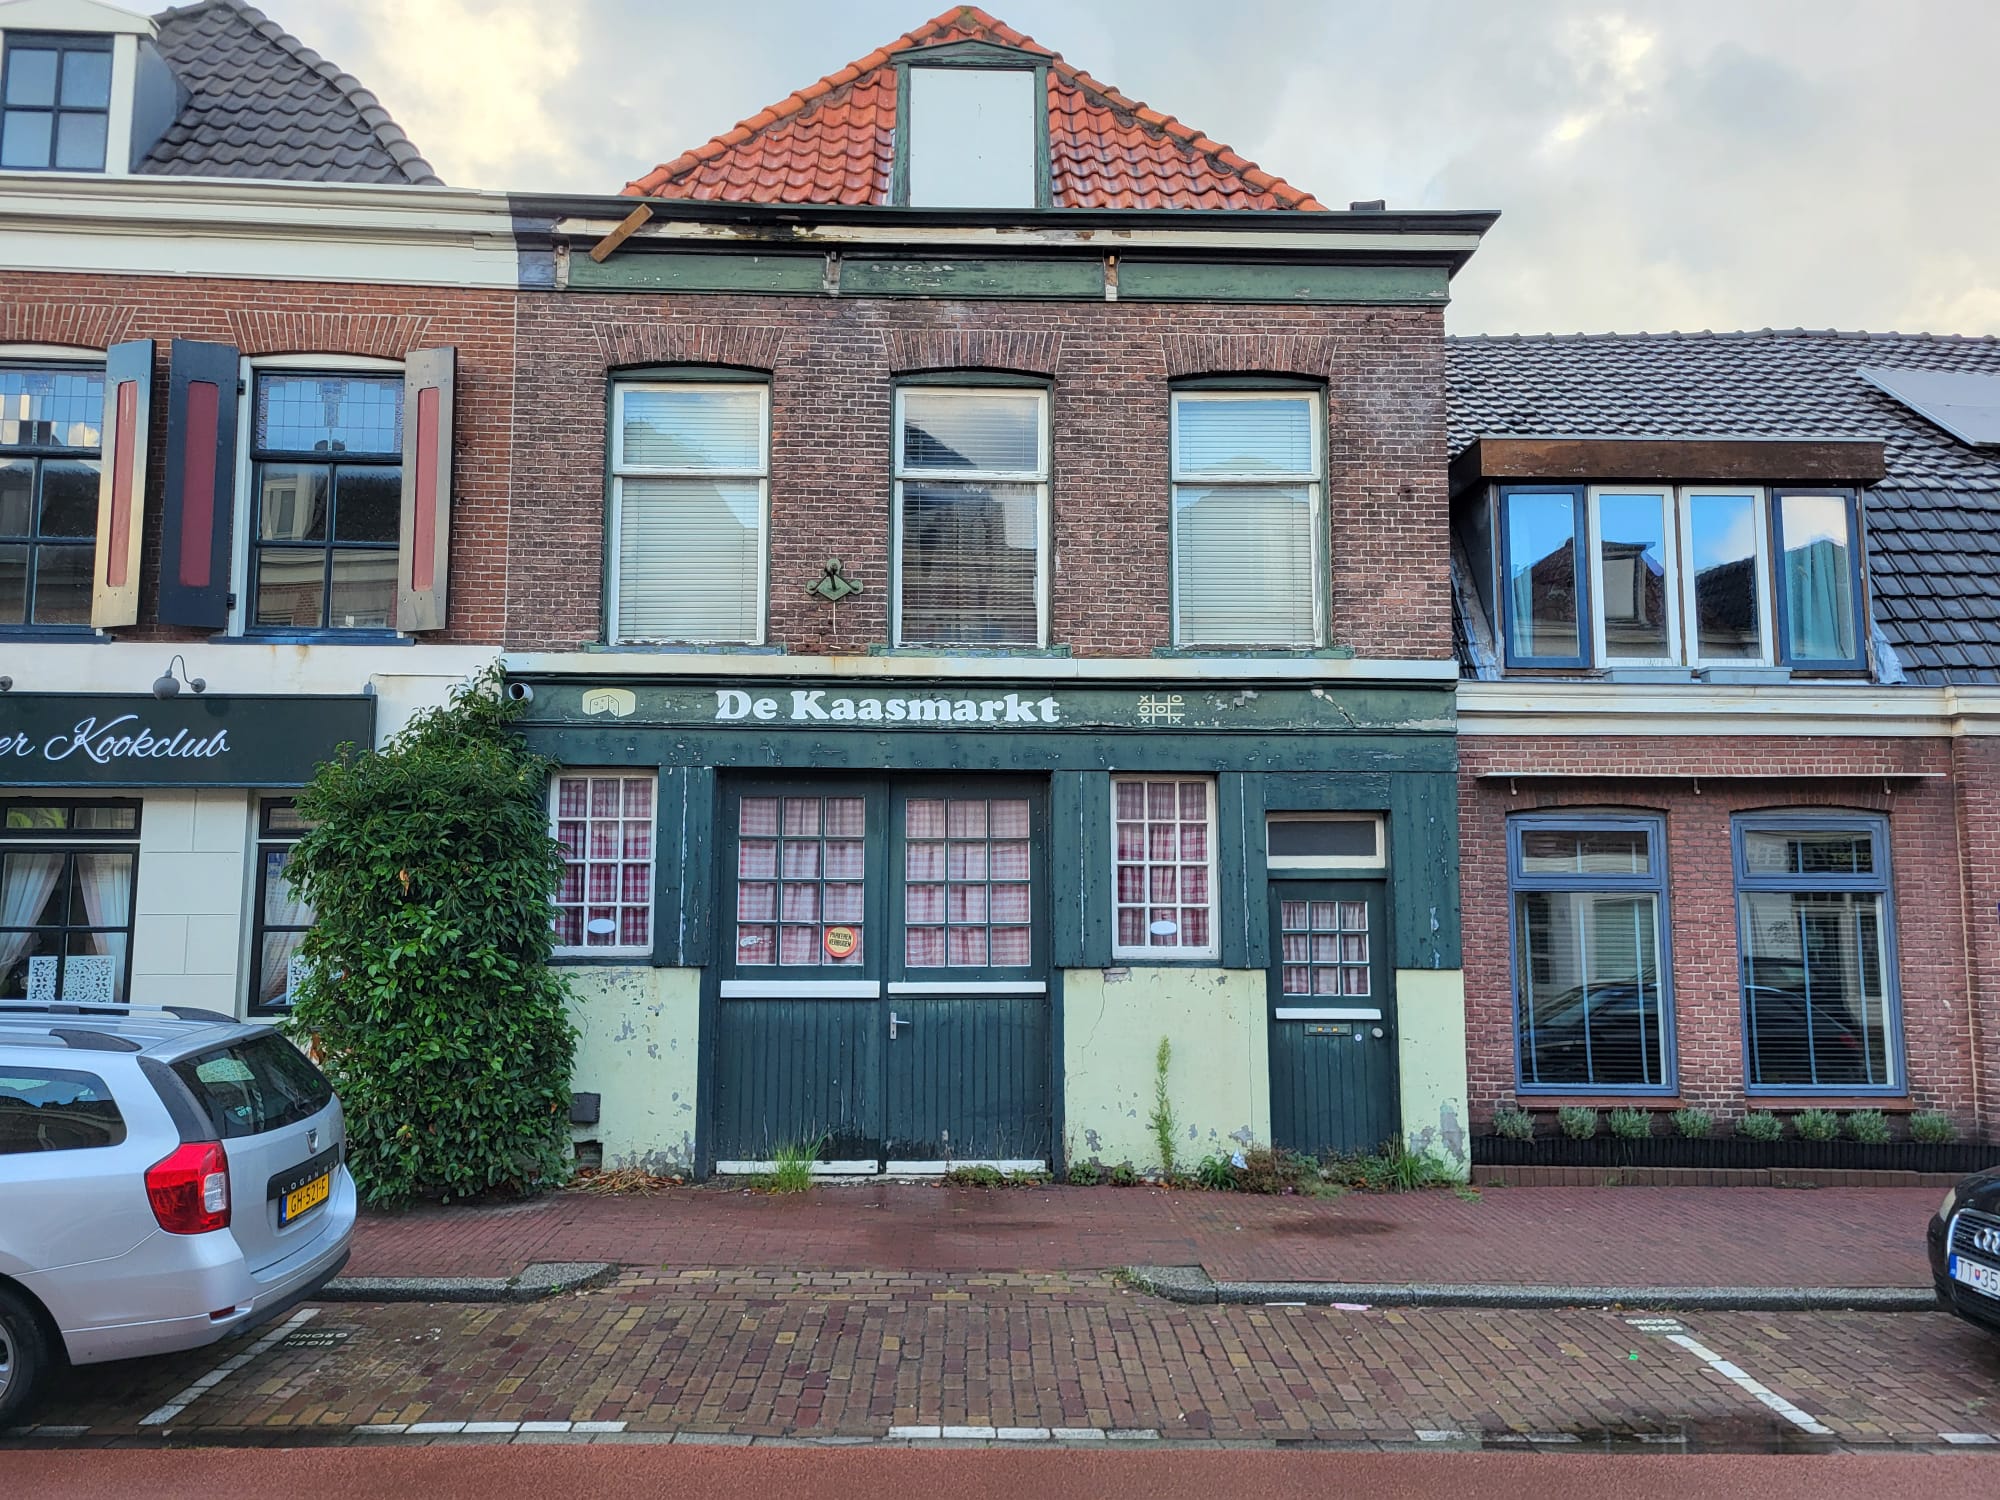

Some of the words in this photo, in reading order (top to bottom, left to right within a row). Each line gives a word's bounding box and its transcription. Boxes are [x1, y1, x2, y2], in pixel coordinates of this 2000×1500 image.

[714, 690, 777, 720] De
[790, 690, 1061, 723] Kaasmarkt
[44, 714, 231, 764] Kookclub
[281, 1169, 319, 1194] LOGAN
[290, 1178, 326, 1213] GH-521-F
